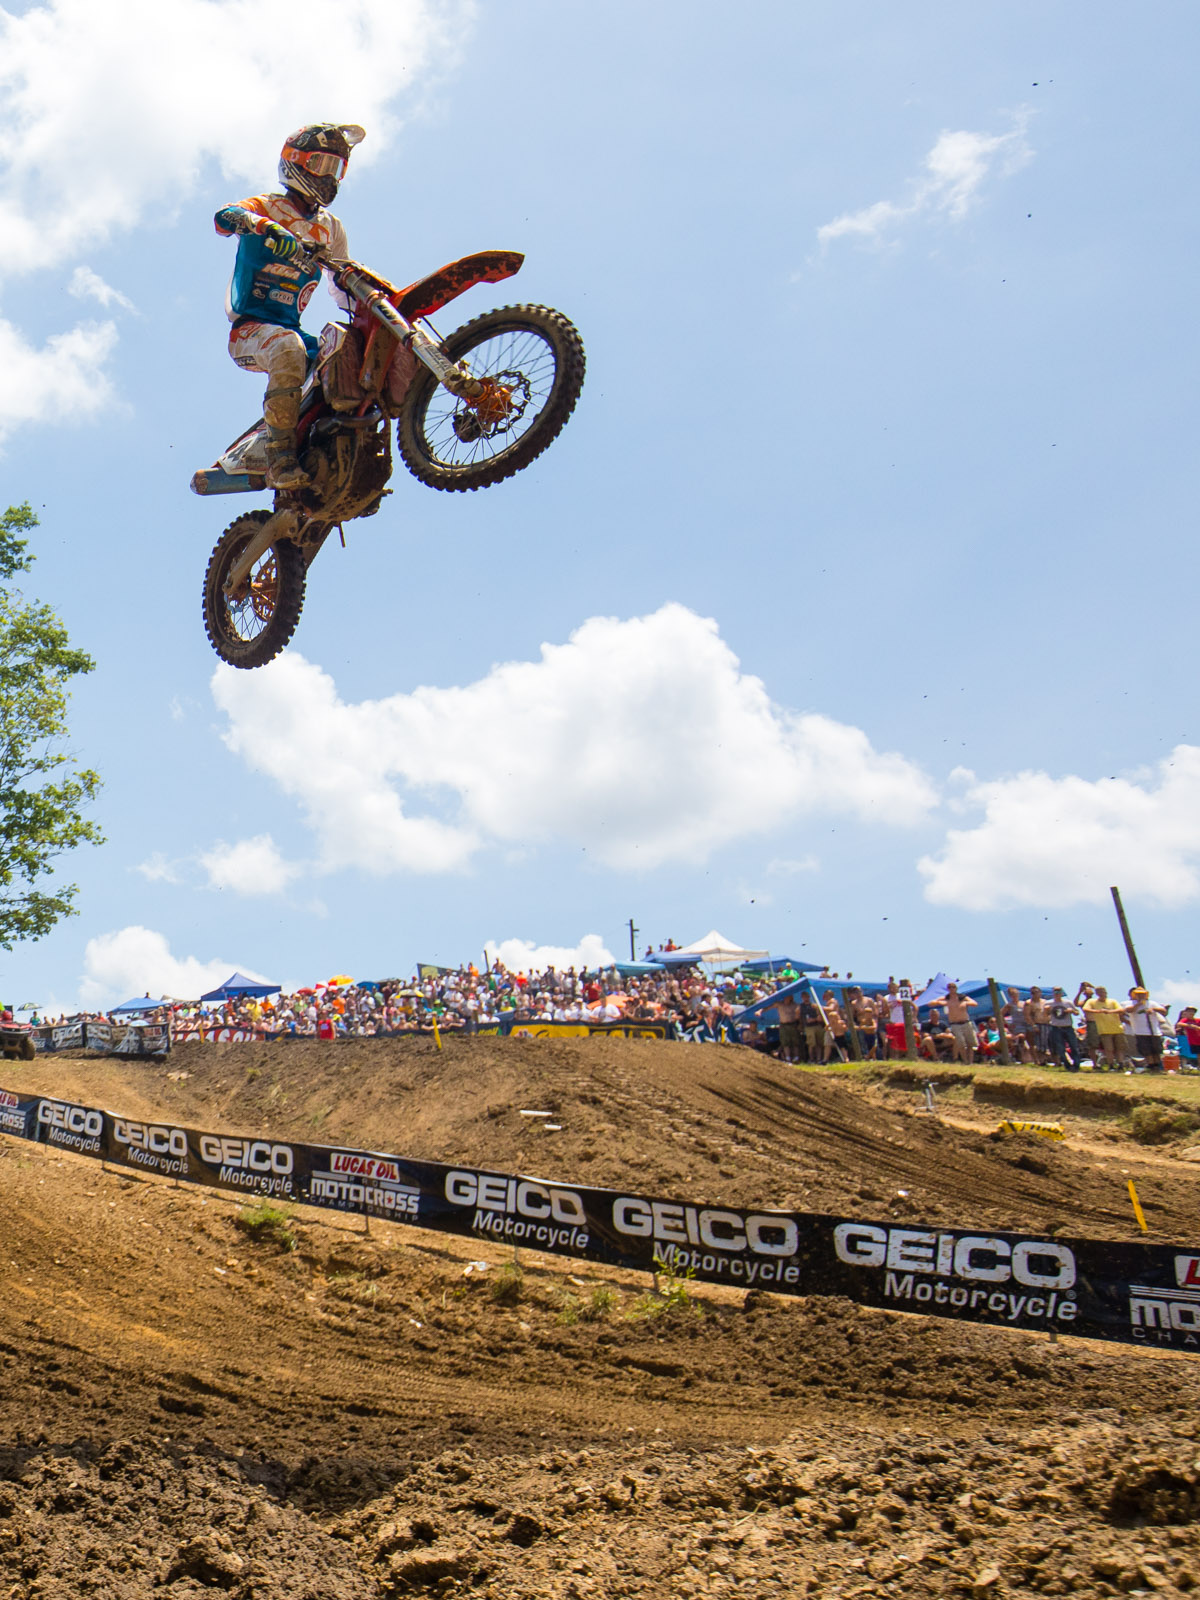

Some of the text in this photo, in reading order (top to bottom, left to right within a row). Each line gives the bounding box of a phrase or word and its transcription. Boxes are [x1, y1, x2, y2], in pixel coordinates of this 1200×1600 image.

[261, 263, 301, 280] KTM
[38, 1100, 103, 1137] GEICO
[50, 1127, 101, 1152] Motorcycle
[113, 1119, 188, 1157] GEICO
[200, 1136, 293, 1175] GEICO
[128, 1146, 189, 1174] Motorcycle
[334, 1155, 397, 1180] LUCAS OIL
[219, 1166, 293, 1194] Motorcycle
[311, 1178, 420, 1214] MOTOCROSS
[445, 1171, 587, 1226] GEICO
[309, 1195, 420, 1221] CHAMPIONSHIP
[472, 1210, 590, 1248] Motorcycle
[612, 1197, 798, 1257] GEICO
[653, 1241, 800, 1284] Motorcycle
[833, 1222, 1077, 1290] GEICO
[884, 1271, 1078, 1320] Motorcycle
